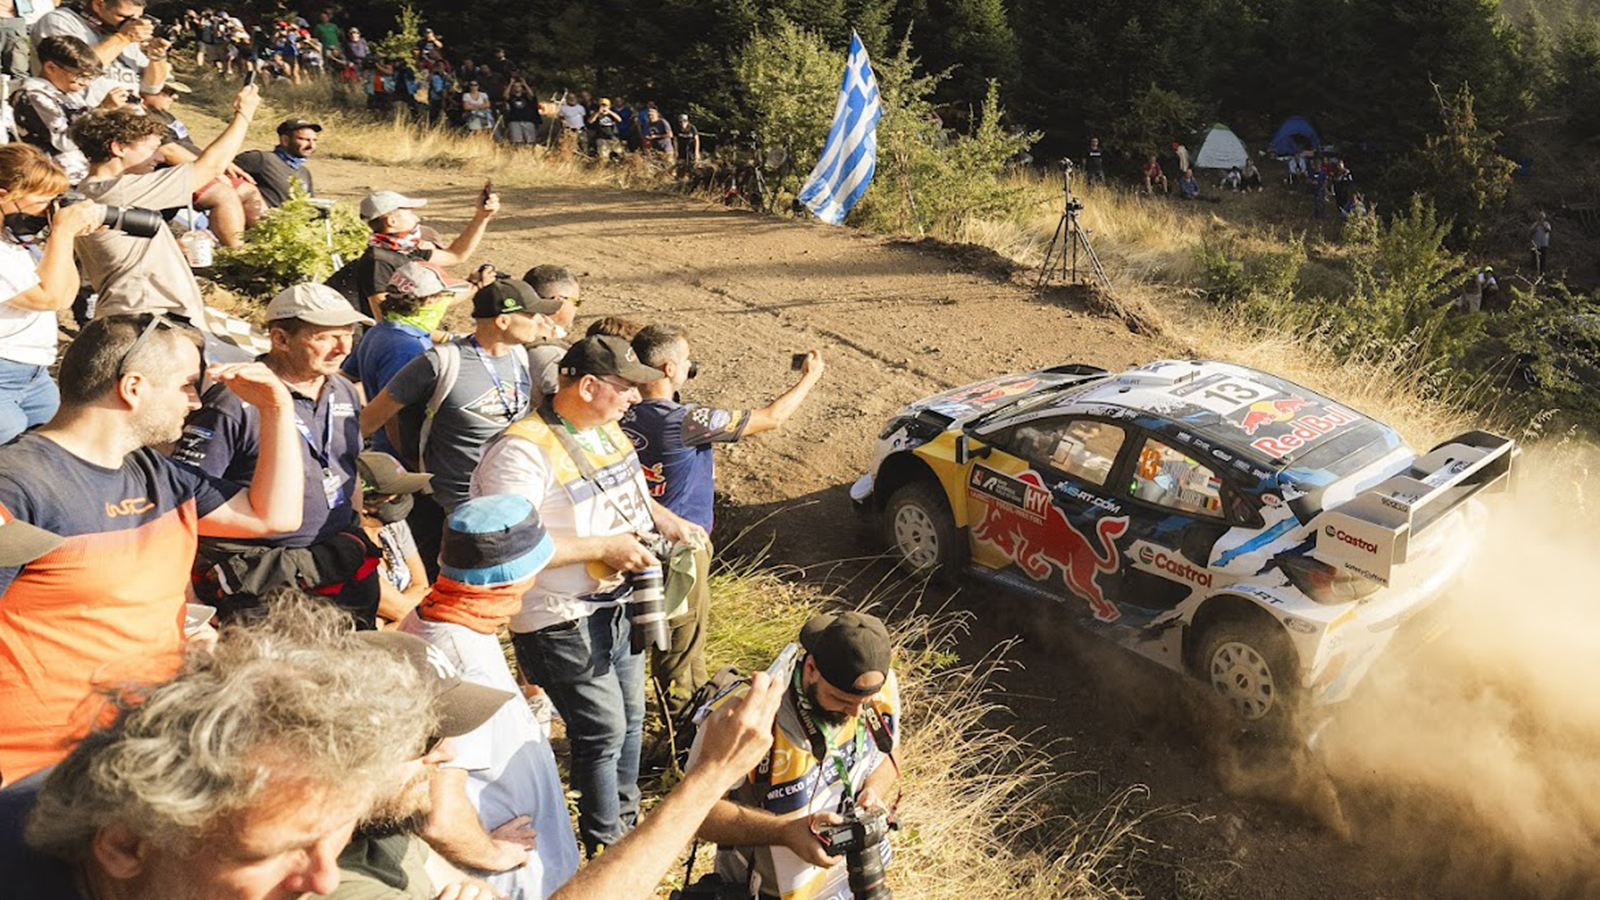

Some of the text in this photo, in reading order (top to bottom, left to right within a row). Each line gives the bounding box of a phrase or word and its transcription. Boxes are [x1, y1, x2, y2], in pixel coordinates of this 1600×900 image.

[1204, 381, 1260, 405] 13
[1251, 405, 1362, 459] Red Bull
[1139, 447, 1161, 481] 13
[1026, 488, 1048, 513] HY
[1336, 529, 1379, 554] Castrol
[1155, 552, 1213, 589] Castrol
[865, 707, 882, 731] EOS
[785, 781, 805, 796] EKO
